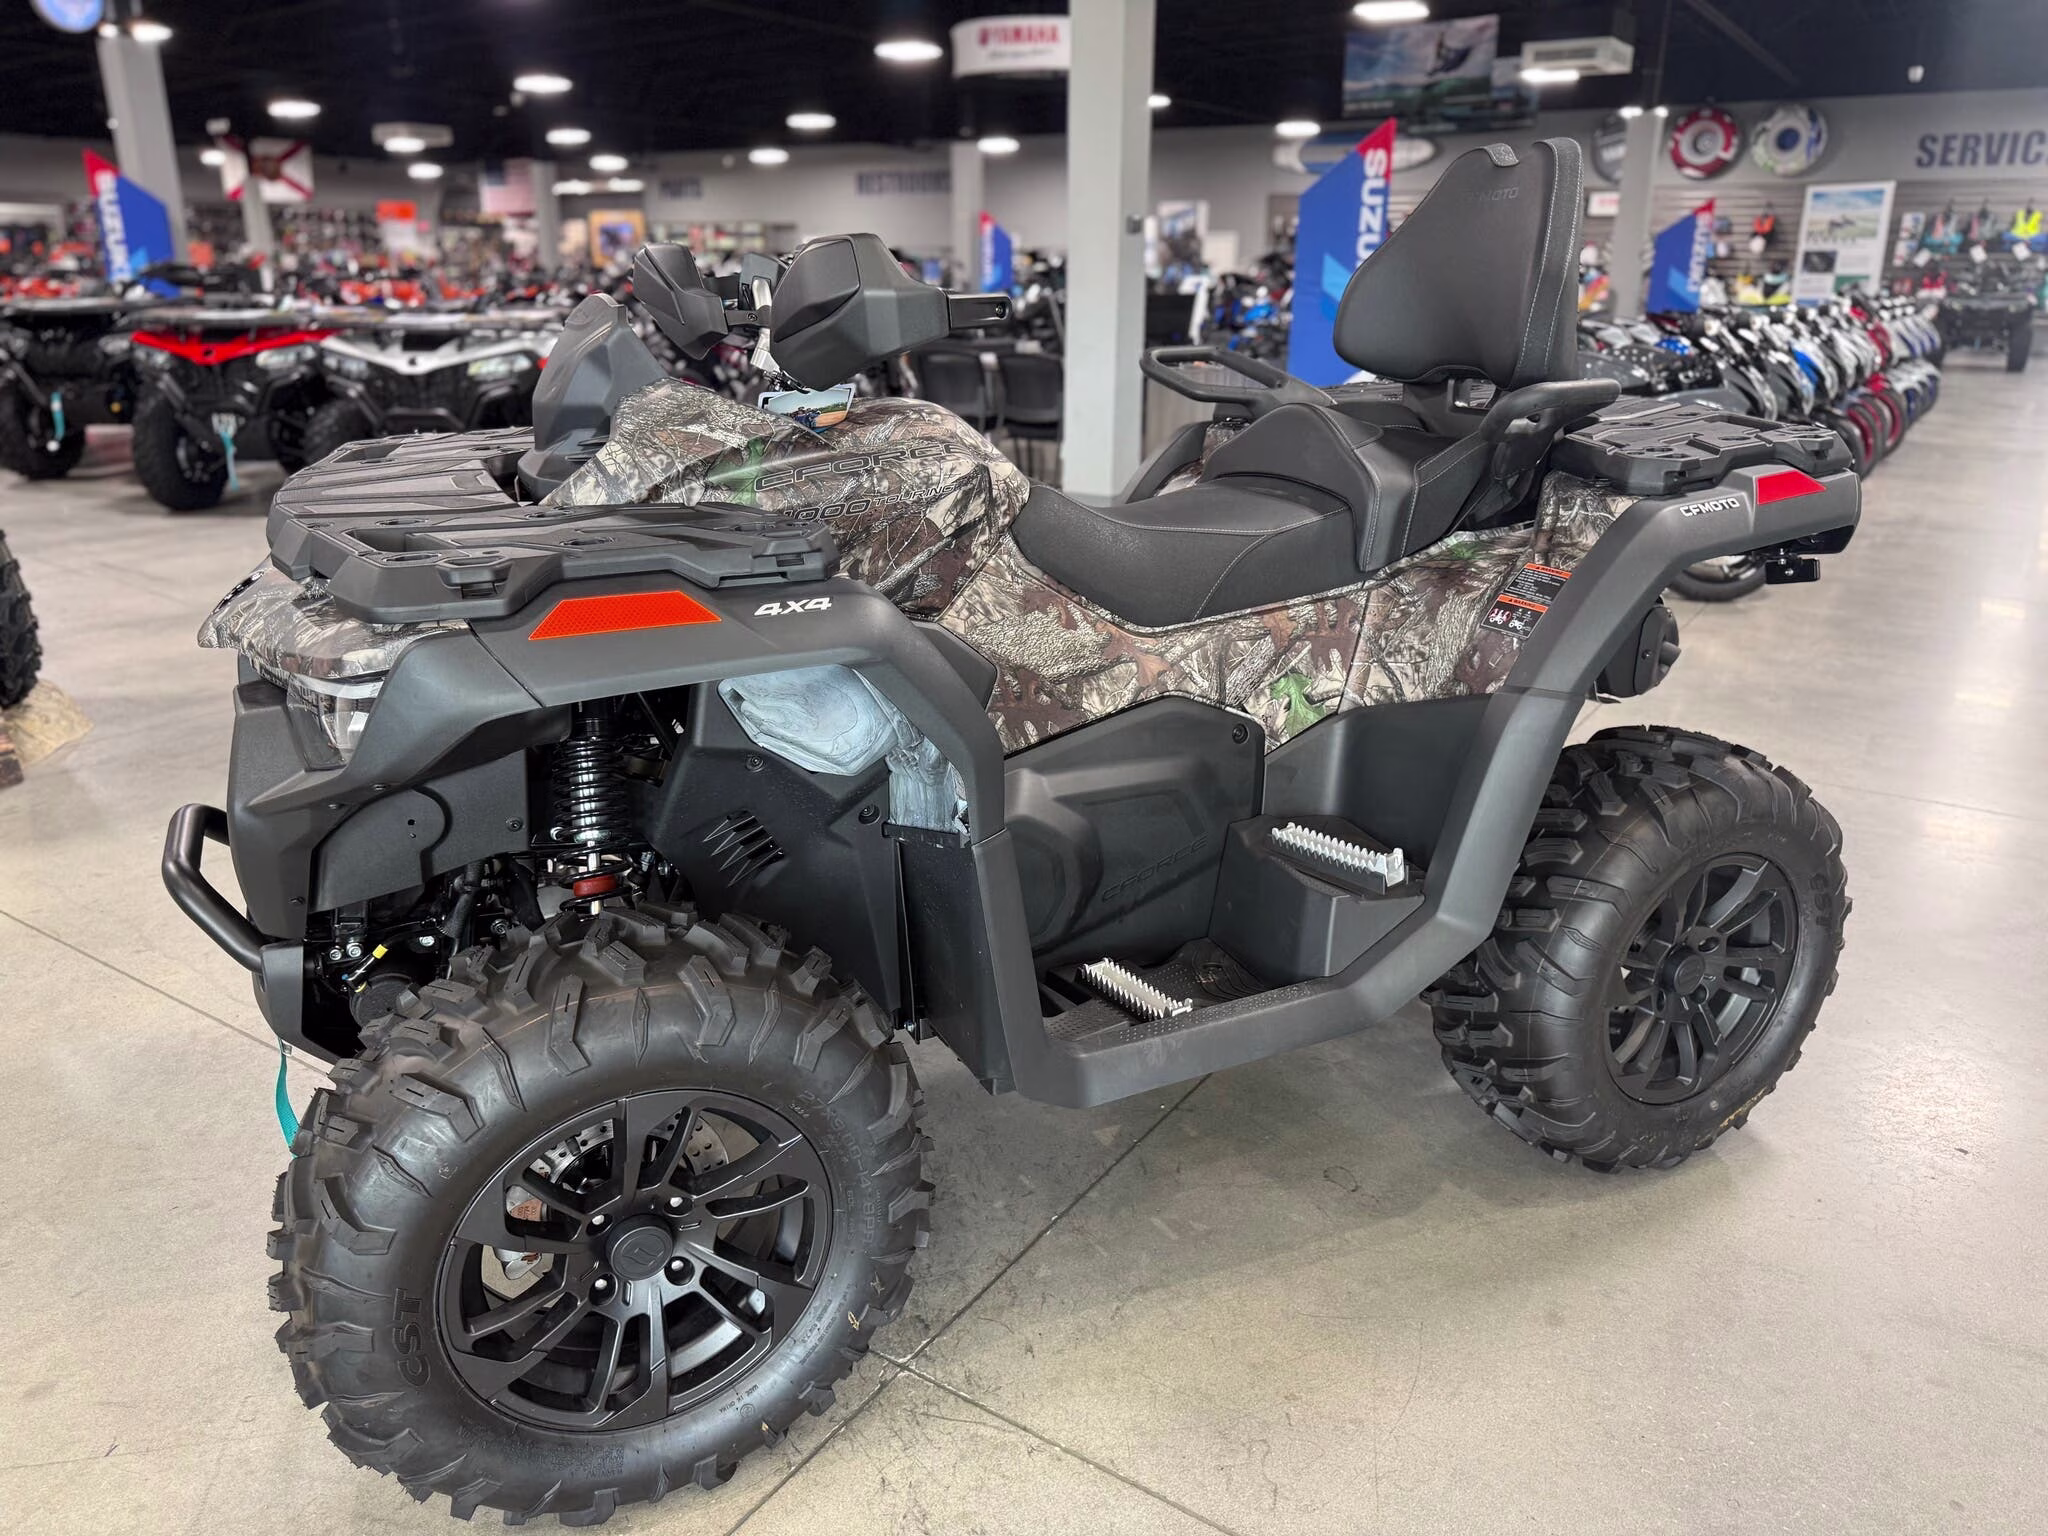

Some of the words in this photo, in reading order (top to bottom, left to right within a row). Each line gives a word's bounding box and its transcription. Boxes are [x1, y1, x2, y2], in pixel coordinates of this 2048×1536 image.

[991, 23, 1061, 45] YAMAHA
[1915, 130, 2048, 168] SERVIC
[1356, 148, 1388, 268] SUZU
[754, 442, 971, 492] CFORCE
[875, 482, 963, 507] TOURING
[1680, 497, 1741, 517] CFMOTO
[392, 1287, 431, 1387] CST
